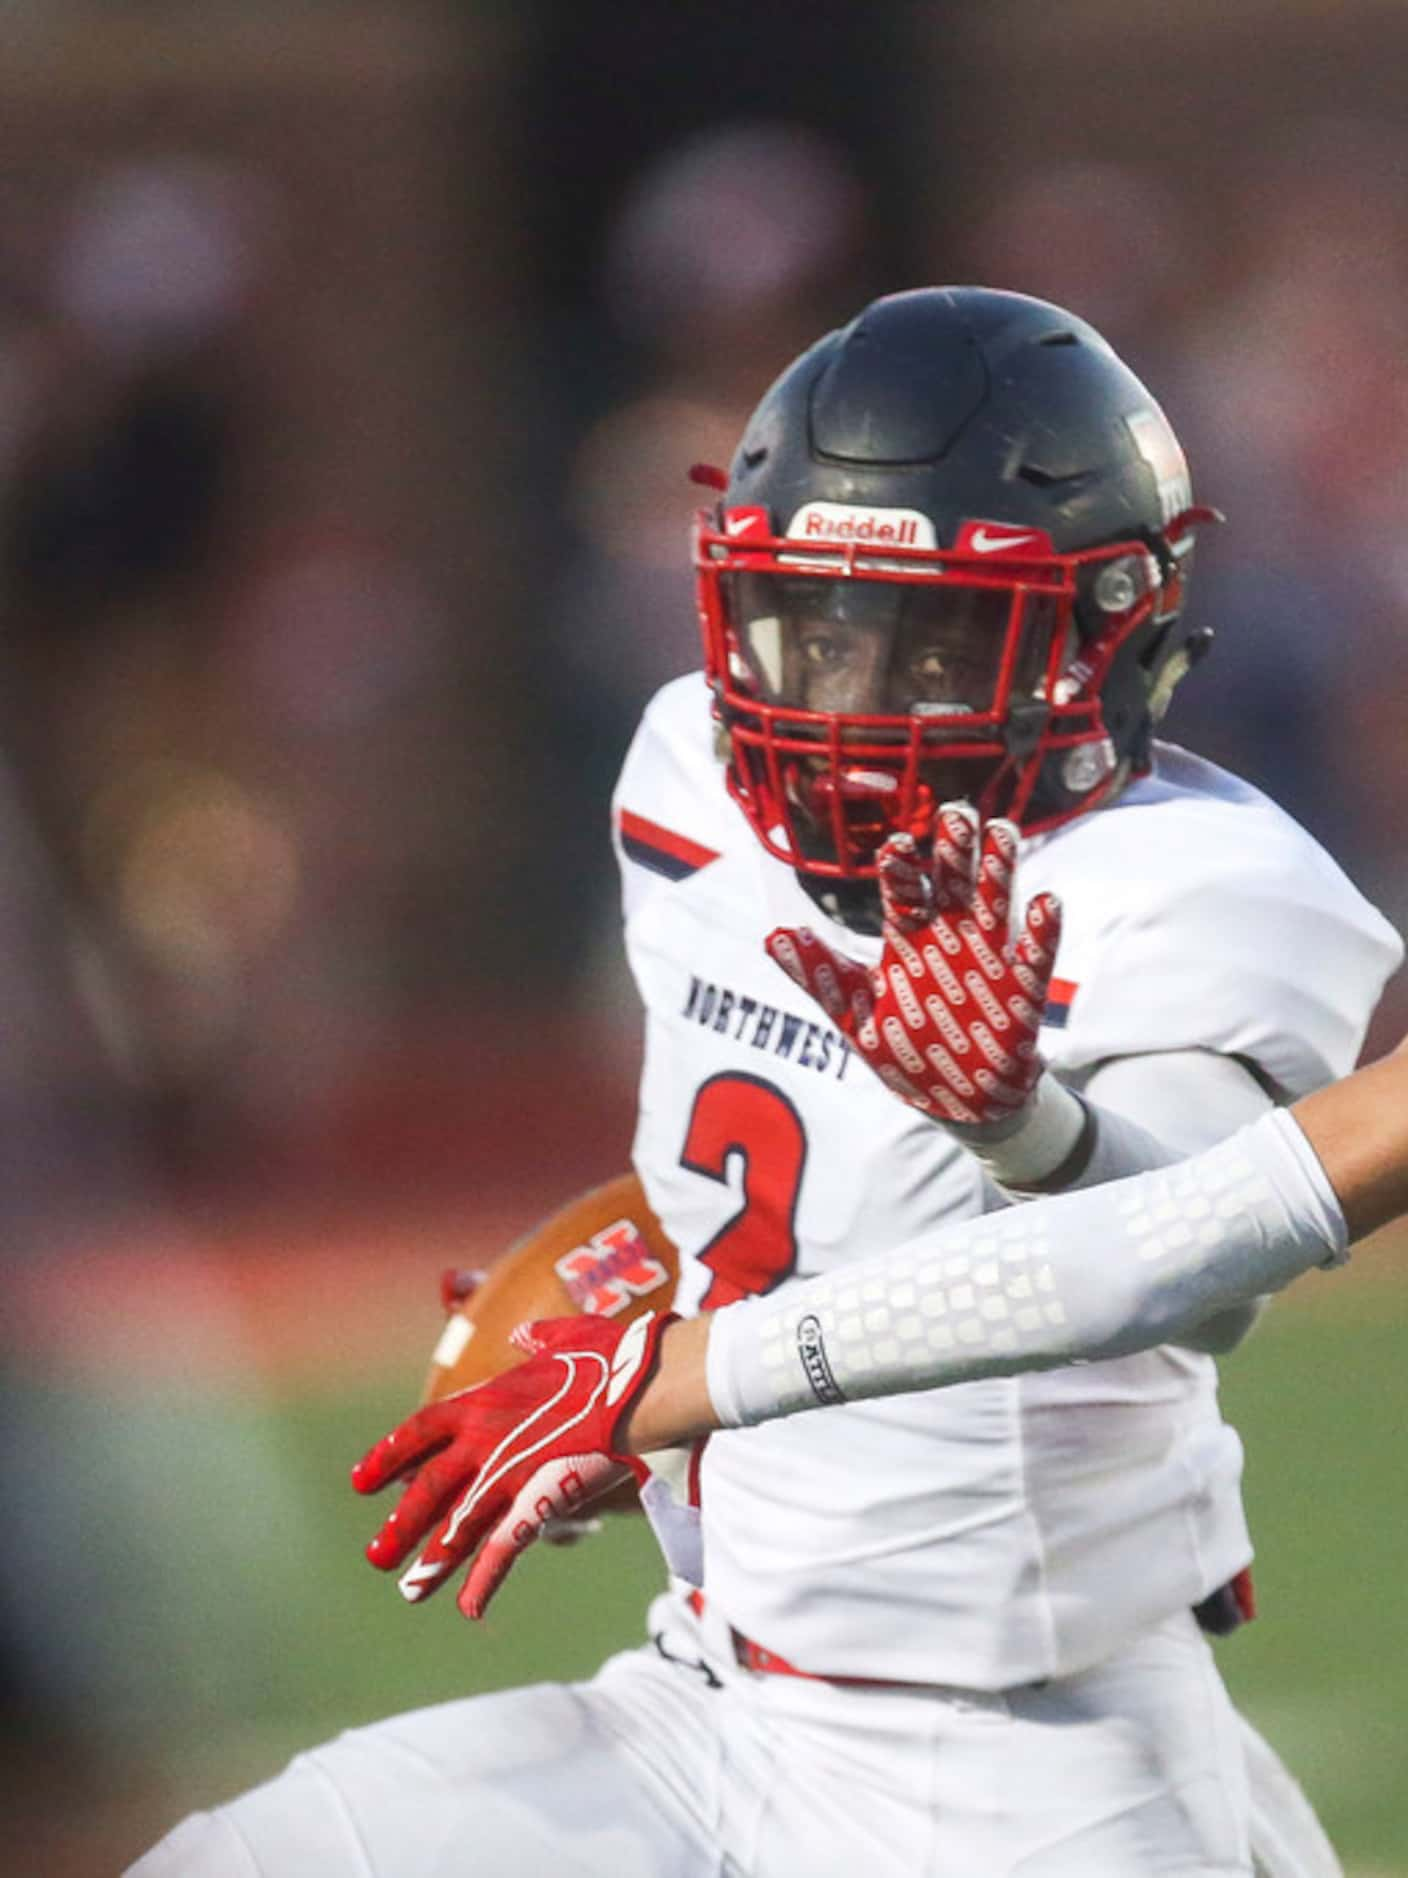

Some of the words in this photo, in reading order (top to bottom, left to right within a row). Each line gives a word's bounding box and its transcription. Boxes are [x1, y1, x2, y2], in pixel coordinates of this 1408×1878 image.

[805, 511, 918, 545] Riddell
[683, 976, 850, 1081] NORTHWEST
[680, 1069, 809, 1312] 2
